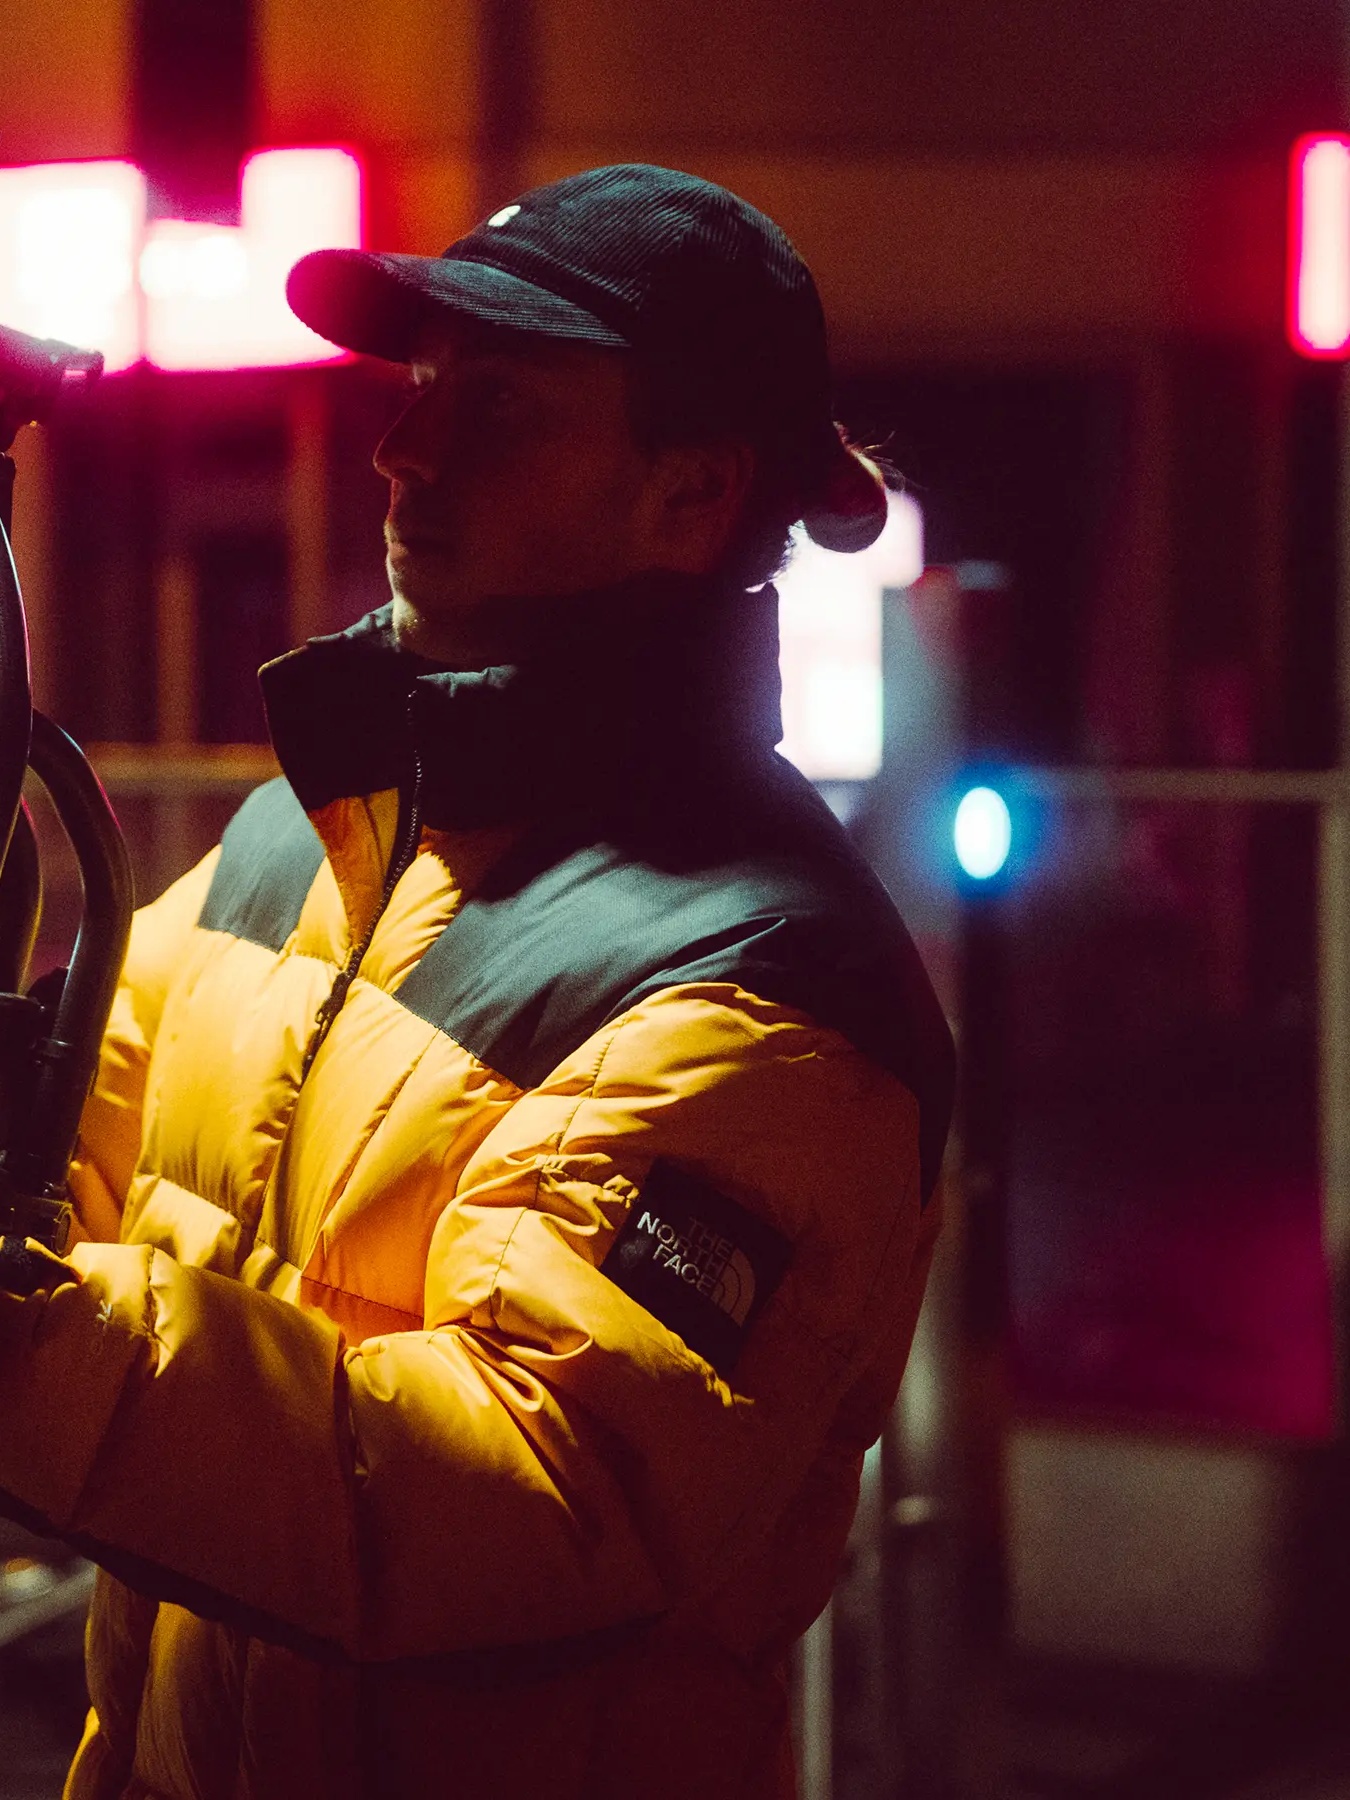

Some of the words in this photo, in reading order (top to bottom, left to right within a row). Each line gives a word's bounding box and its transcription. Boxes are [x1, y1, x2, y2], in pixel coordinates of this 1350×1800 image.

[637, 1211, 724, 1278] NORTH
[689, 1216, 733, 1259] THE
[653, 1244, 715, 1297] FACE
